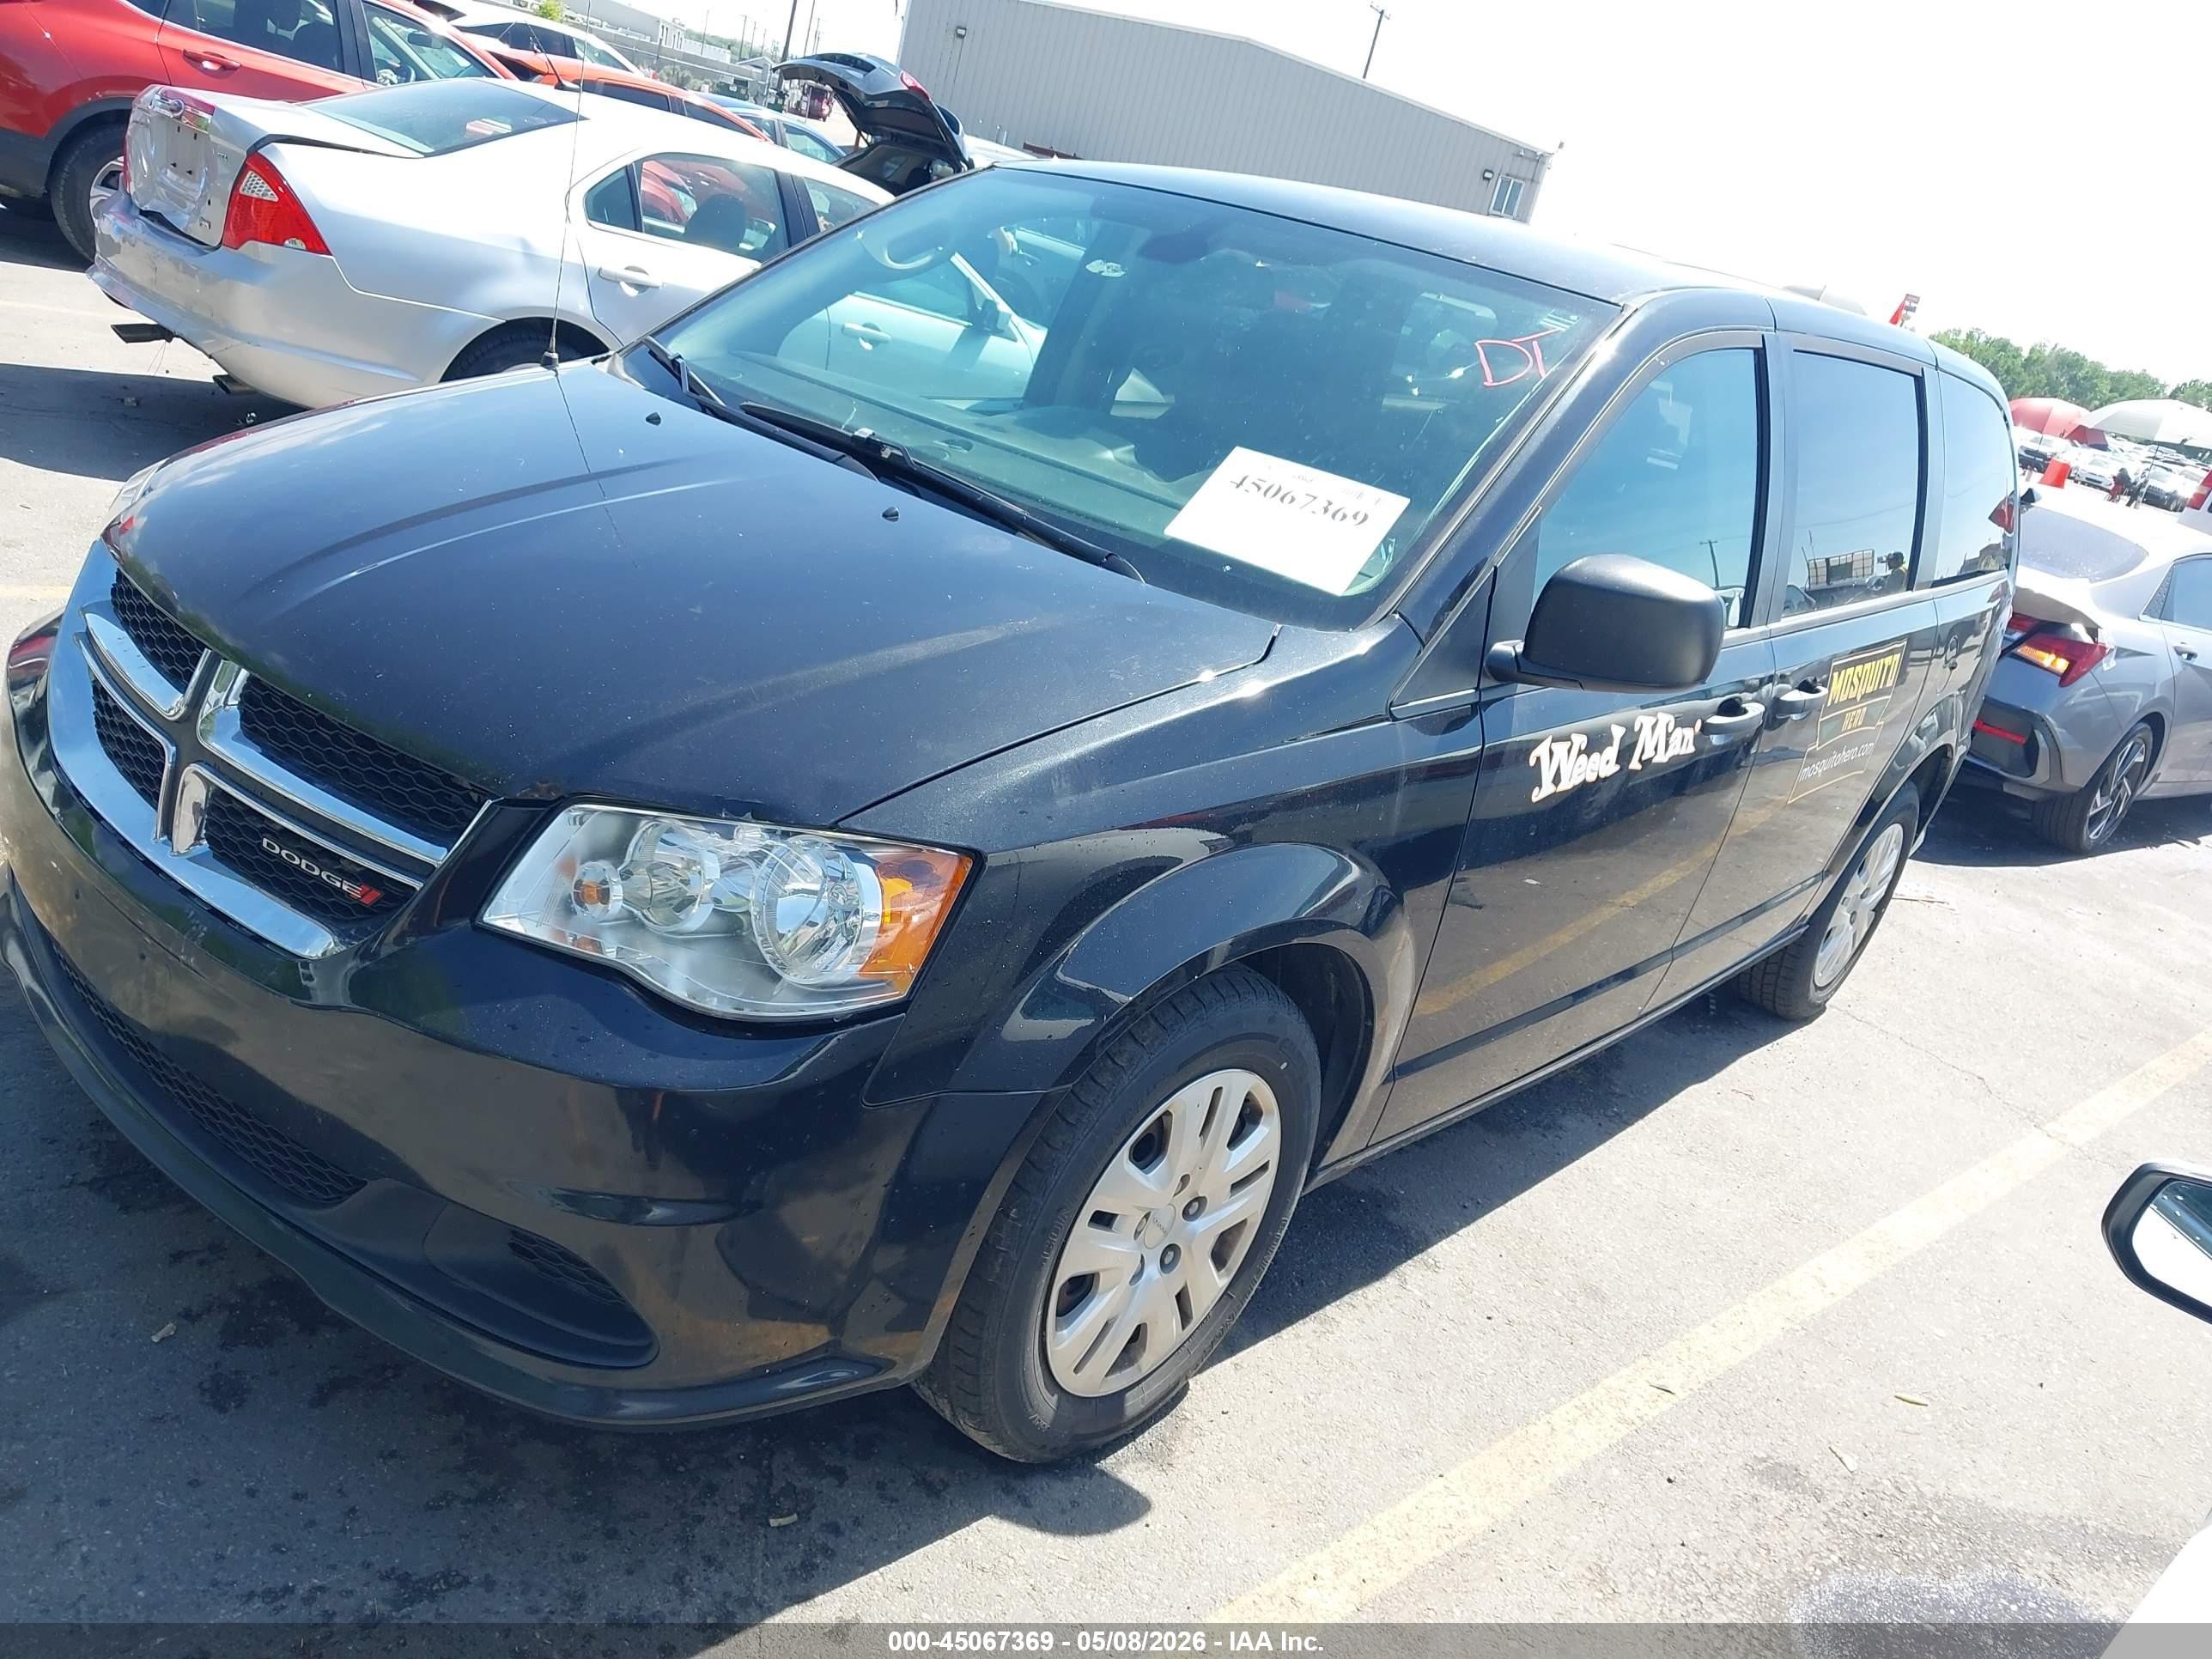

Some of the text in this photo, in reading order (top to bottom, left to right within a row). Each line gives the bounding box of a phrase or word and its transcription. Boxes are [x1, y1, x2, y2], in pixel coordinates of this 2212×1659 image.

[1230, 475, 1369, 526] 45067369
[1827, 653, 1901, 707] MOSQUITO
[1841, 707, 1868, 732] HERO
[1528, 724, 1626, 803] Weed
[1799, 741, 1875, 782] mosquitohero.com
[262, 837, 362, 899] DODGE
